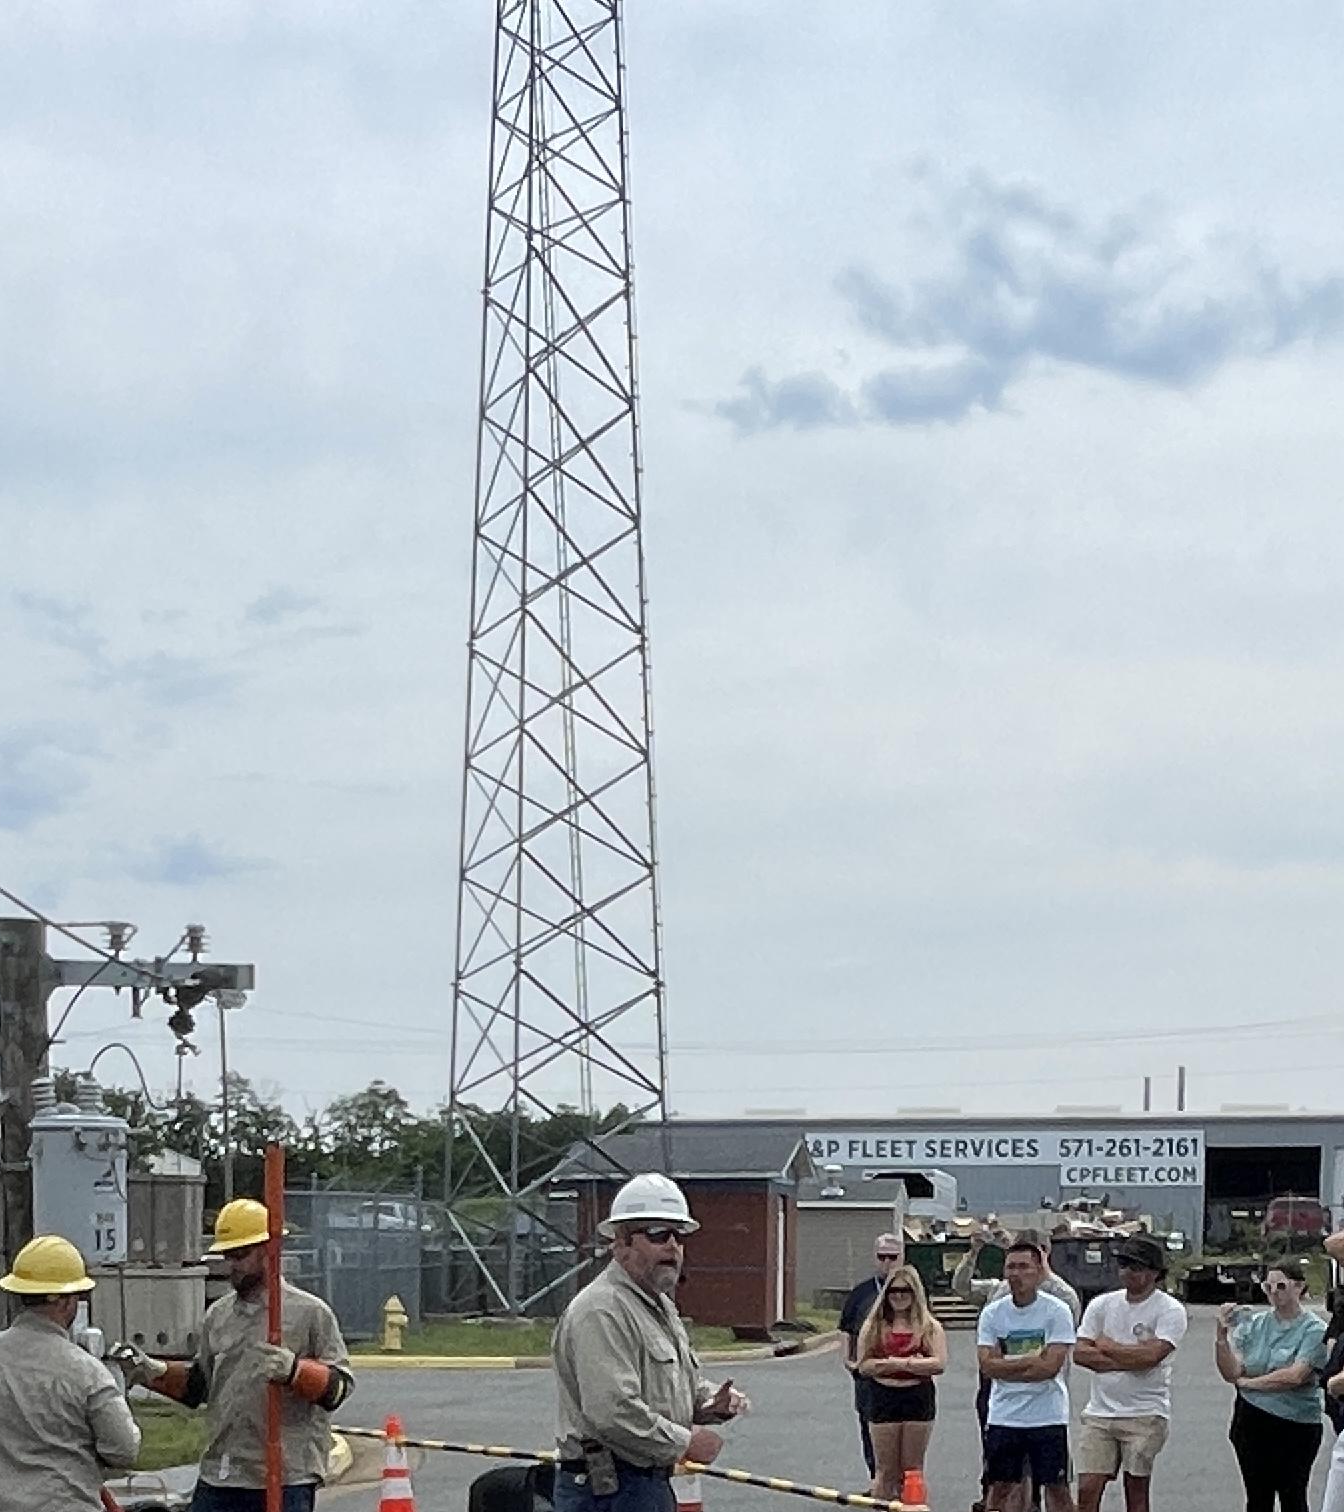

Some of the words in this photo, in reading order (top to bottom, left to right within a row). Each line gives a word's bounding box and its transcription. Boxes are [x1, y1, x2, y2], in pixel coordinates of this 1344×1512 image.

[807, 1139, 840, 1158] &P
[849, 1139, 917, 1159] FLEET
[924, 1139, 1039, 1158] SERVICES
[1059, 1137, 1199, 1158] 571-261-2161
[1066, 1166, 1198, 1183] CPFLEET.COM
[96, 1228, 116, 1251] 15
